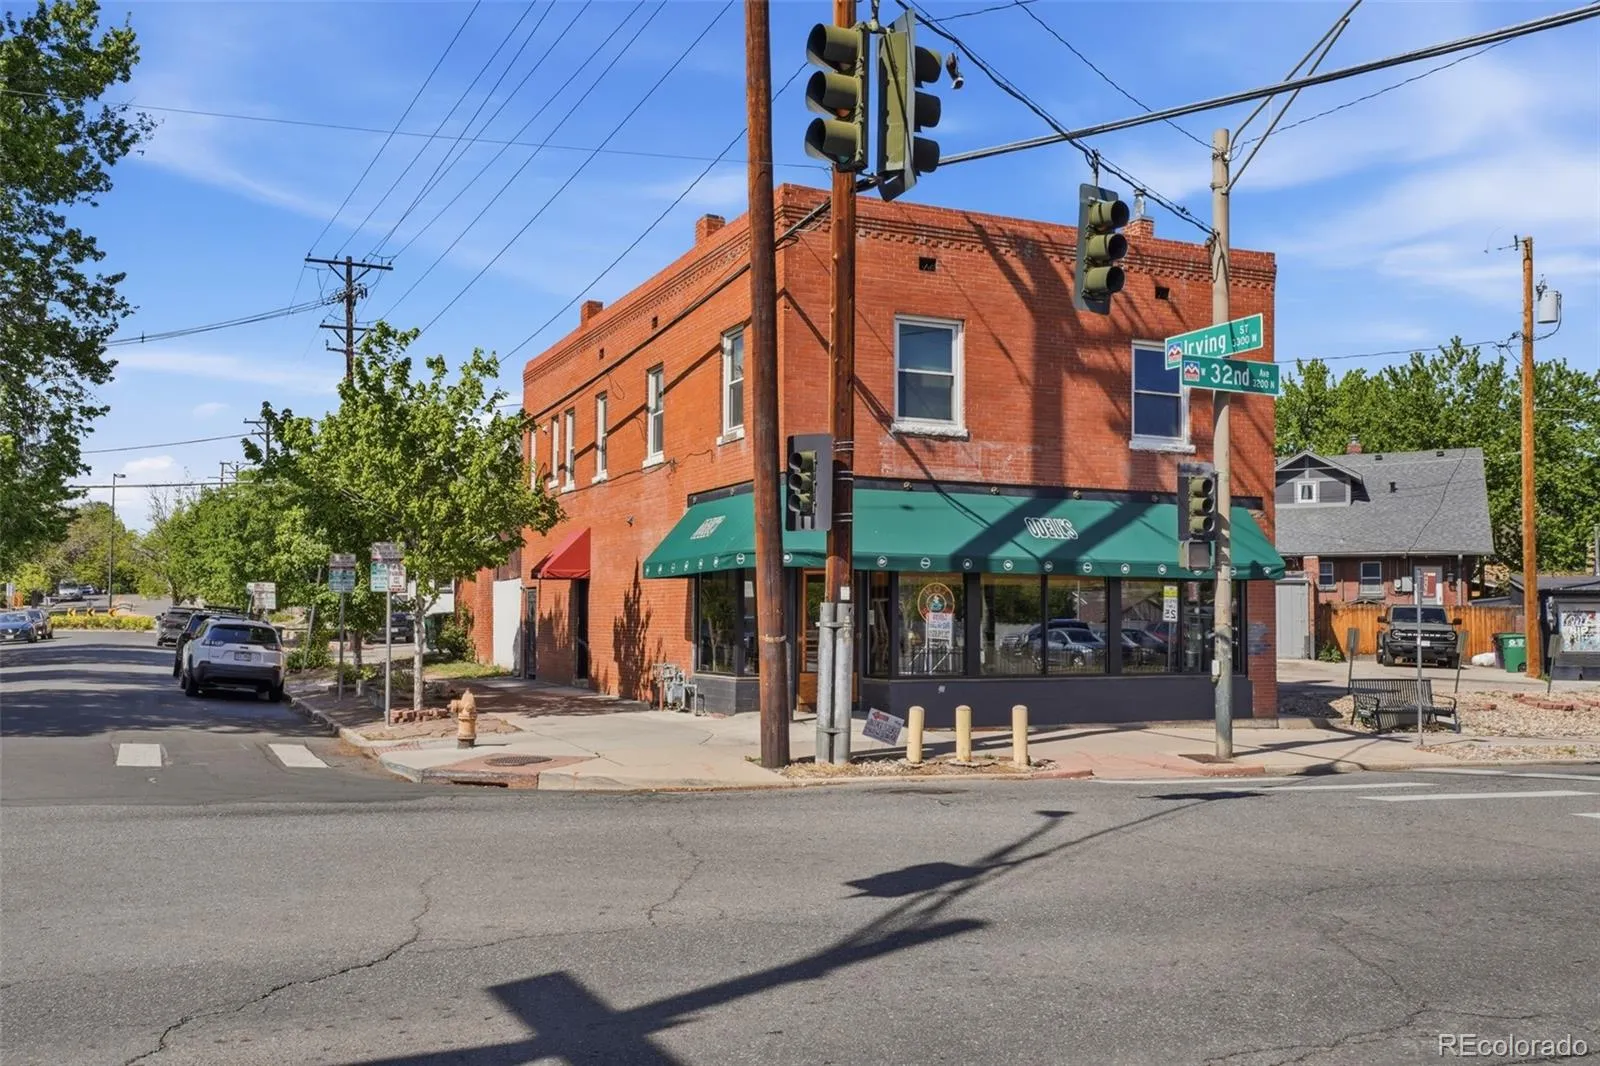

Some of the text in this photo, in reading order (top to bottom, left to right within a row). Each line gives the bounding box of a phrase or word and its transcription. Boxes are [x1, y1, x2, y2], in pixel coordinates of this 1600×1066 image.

[1240, 324, 1249, 334] ST
[1252, 333, 1257, 342] W
[1184, 334, 1226, 354] Irving
[1200, 363, 1250, 386] W 32nd
[1259, 368, 1270, 378] Ave
[1252, 379, 1269, 389] 3200
